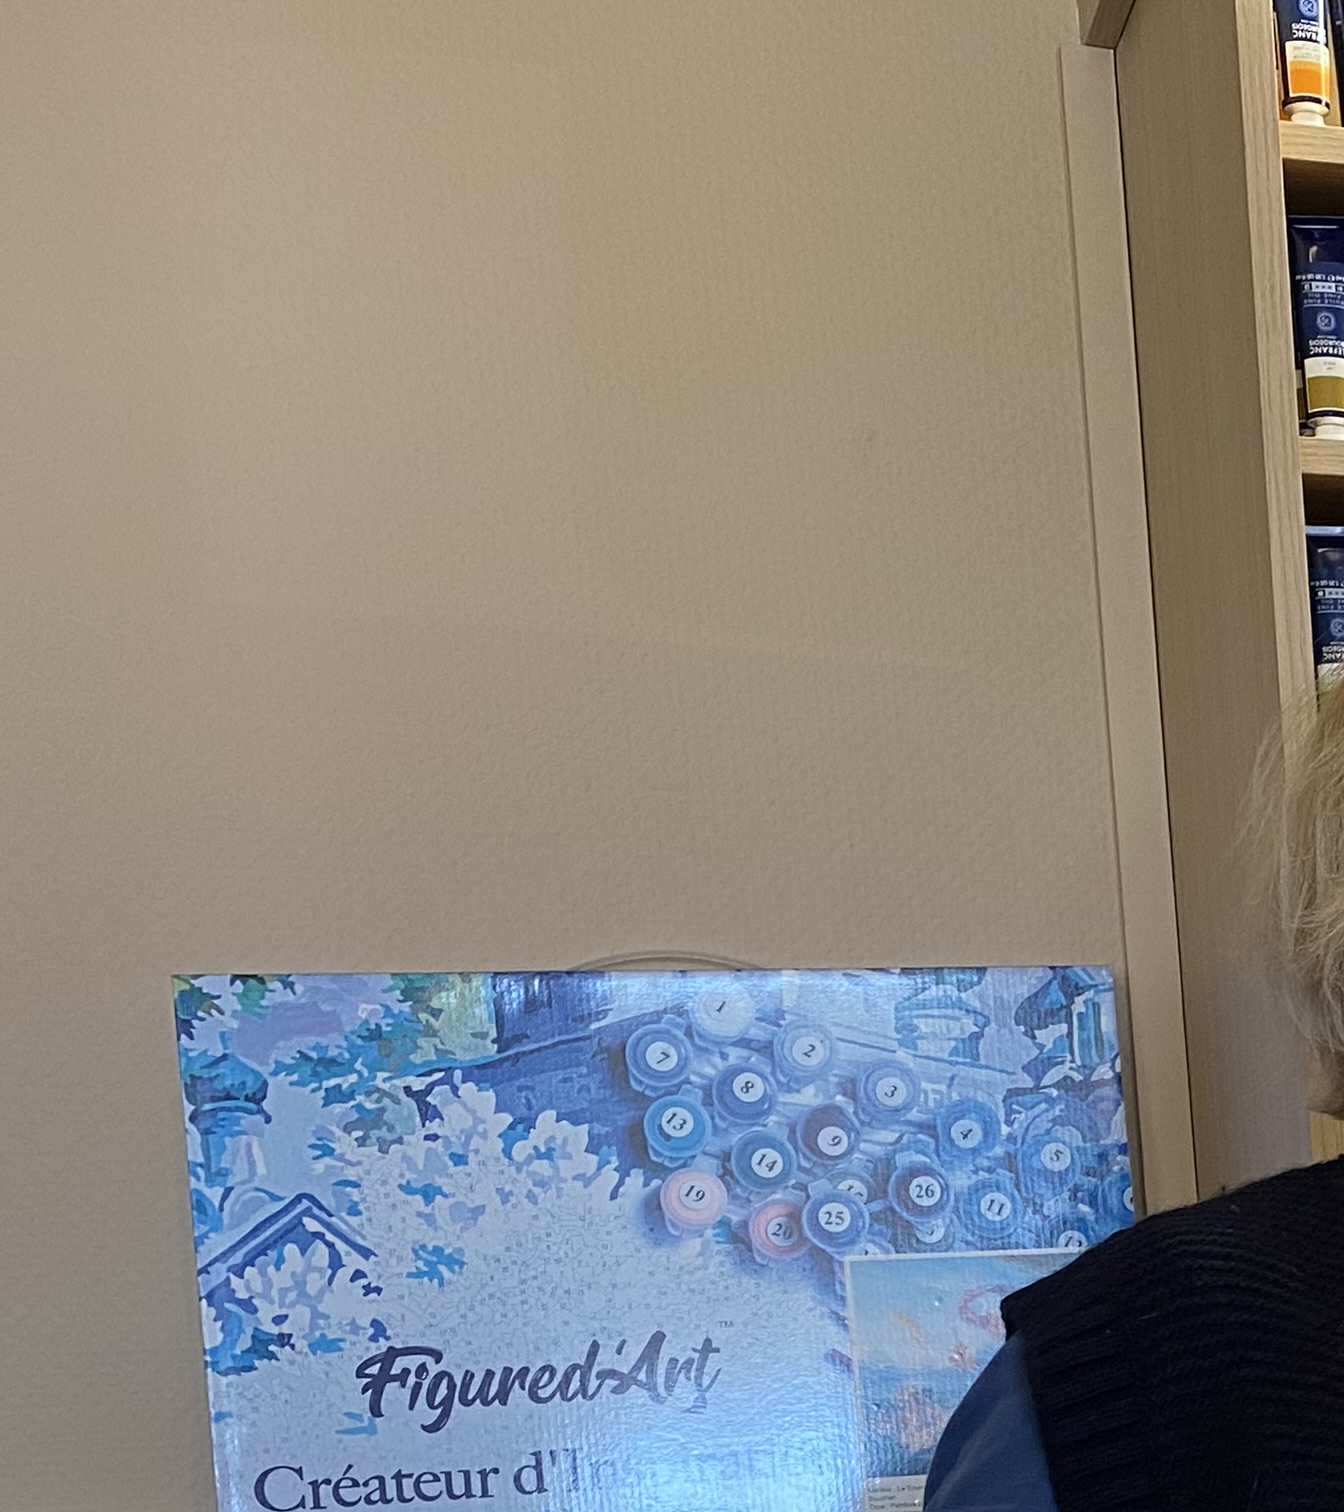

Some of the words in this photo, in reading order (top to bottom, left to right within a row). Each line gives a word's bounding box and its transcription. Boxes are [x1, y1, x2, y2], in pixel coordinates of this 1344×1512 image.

[663, 1111, 689, 1133] 13
[755, 1153, 778, 1174] 14
[682, 1185, 708, 1205] 19
[913, 1182, 936, 1201] 26
[822, 1209, 846, 1227] 25
[985, 1197, 1007, 1218] 11
[769, 1221, 794, 1242] 20
